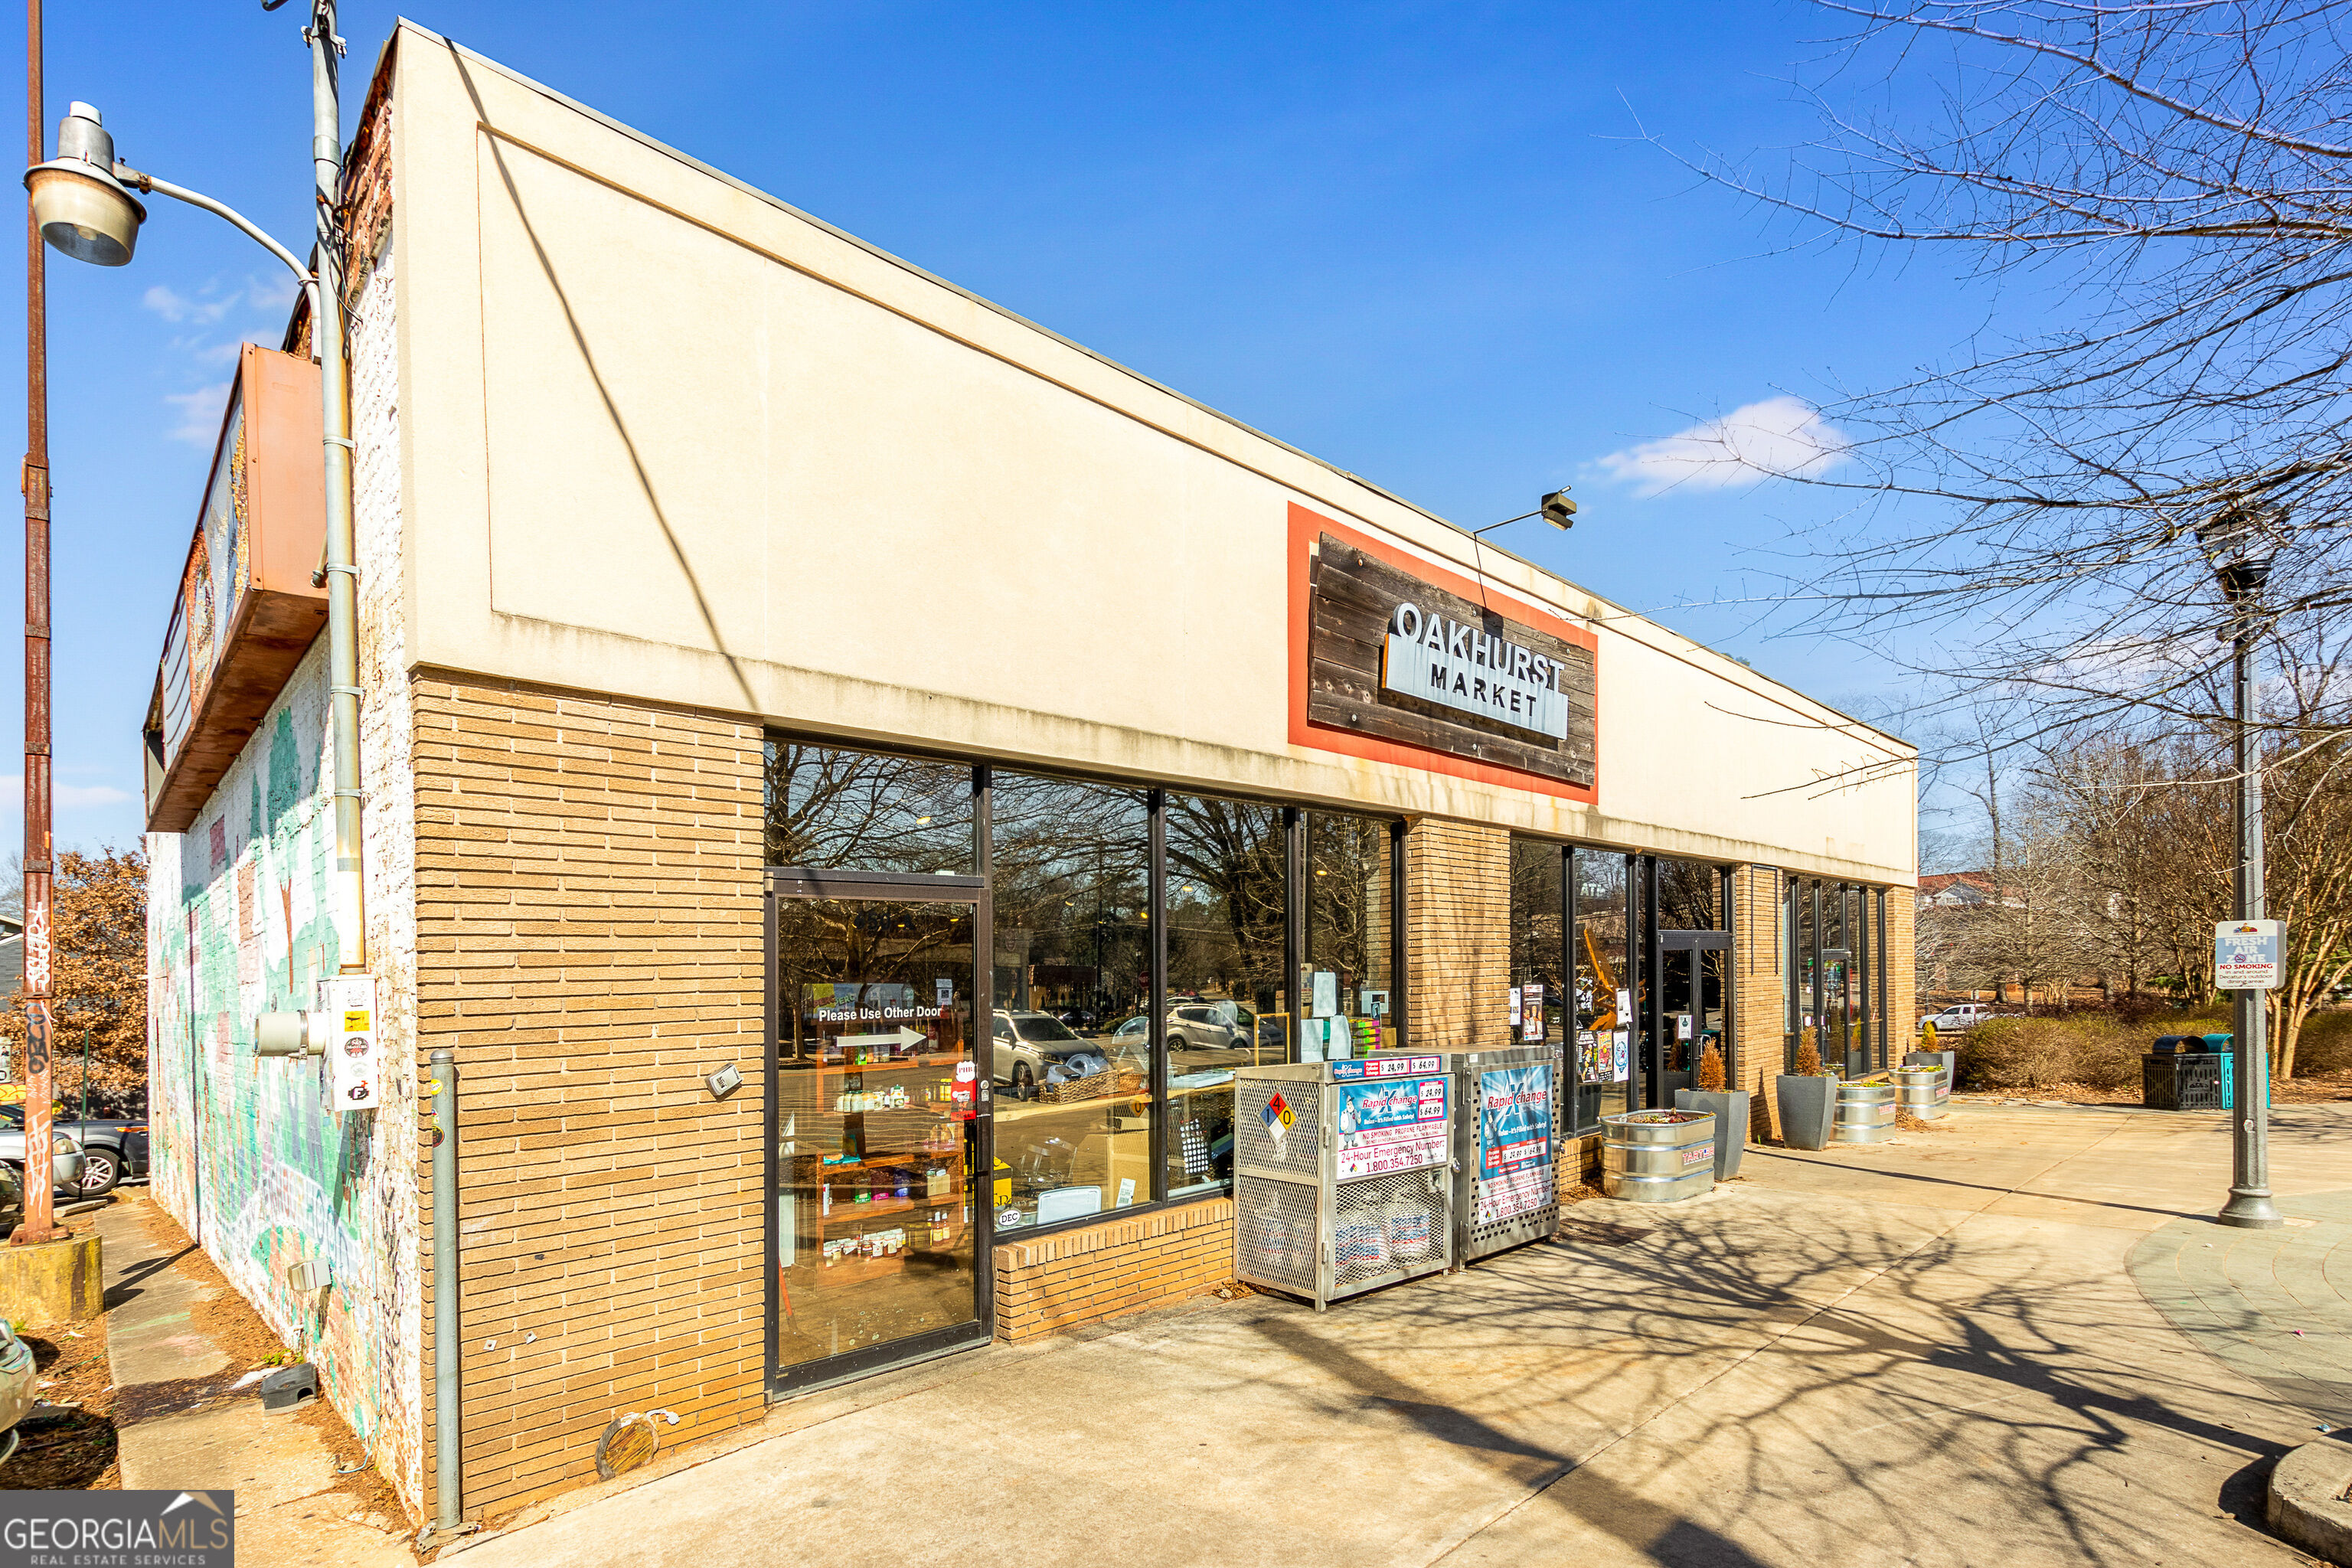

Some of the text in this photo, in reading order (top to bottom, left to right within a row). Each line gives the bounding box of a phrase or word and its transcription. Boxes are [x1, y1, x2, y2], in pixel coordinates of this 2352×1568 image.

[1393, 602, 1565, 694] OAKHURST
[1430, 663, 1537, 717] MARKET
[2224, 936, 2268, 946] FRESH
[2233, 946, 2259, 954] AIR
[818, 1006, 942, 1021] Please Use Other Door
[1387, 1063, 1404, 1072] 24.99
[1419, 1060, 1435, 1070] 64.99
[1426, 1088, 1441, 1097] 24.99
[1272, 1096, 1280, 1110] 4
[1266, 1109, 1291, 1125] 1 0
[1424, 1106, 1441, 1116] 64.99
[1371, 1130, 1392, 1139] SMOKING
[1395, 1126, 1415, 1135] PROPANE
[1416, 1122, 1442, 1132] FLAMMABLE
[1341, 1139, 1445, 1163] 24-Hour Emergency Number:
[1510, 1150, 1522, 1158] 24.99
[1530, 1145, 1541, 1155] 64.99
[1367, 1154, 1423, 1172] 1.800.354.7250
[1494, 1178, 1509, 1187] SMOKING
[1511, 1174, 1525, 1183] PROPANE
[1480, 1198, 1501, 1210] 24-Hour
[1502, 1190, 1530, 1204] Emergency
[1496, 1198, 1537, 1218] 1.800.354.7250
[1001, 1213, 1018, 1223] DEC
